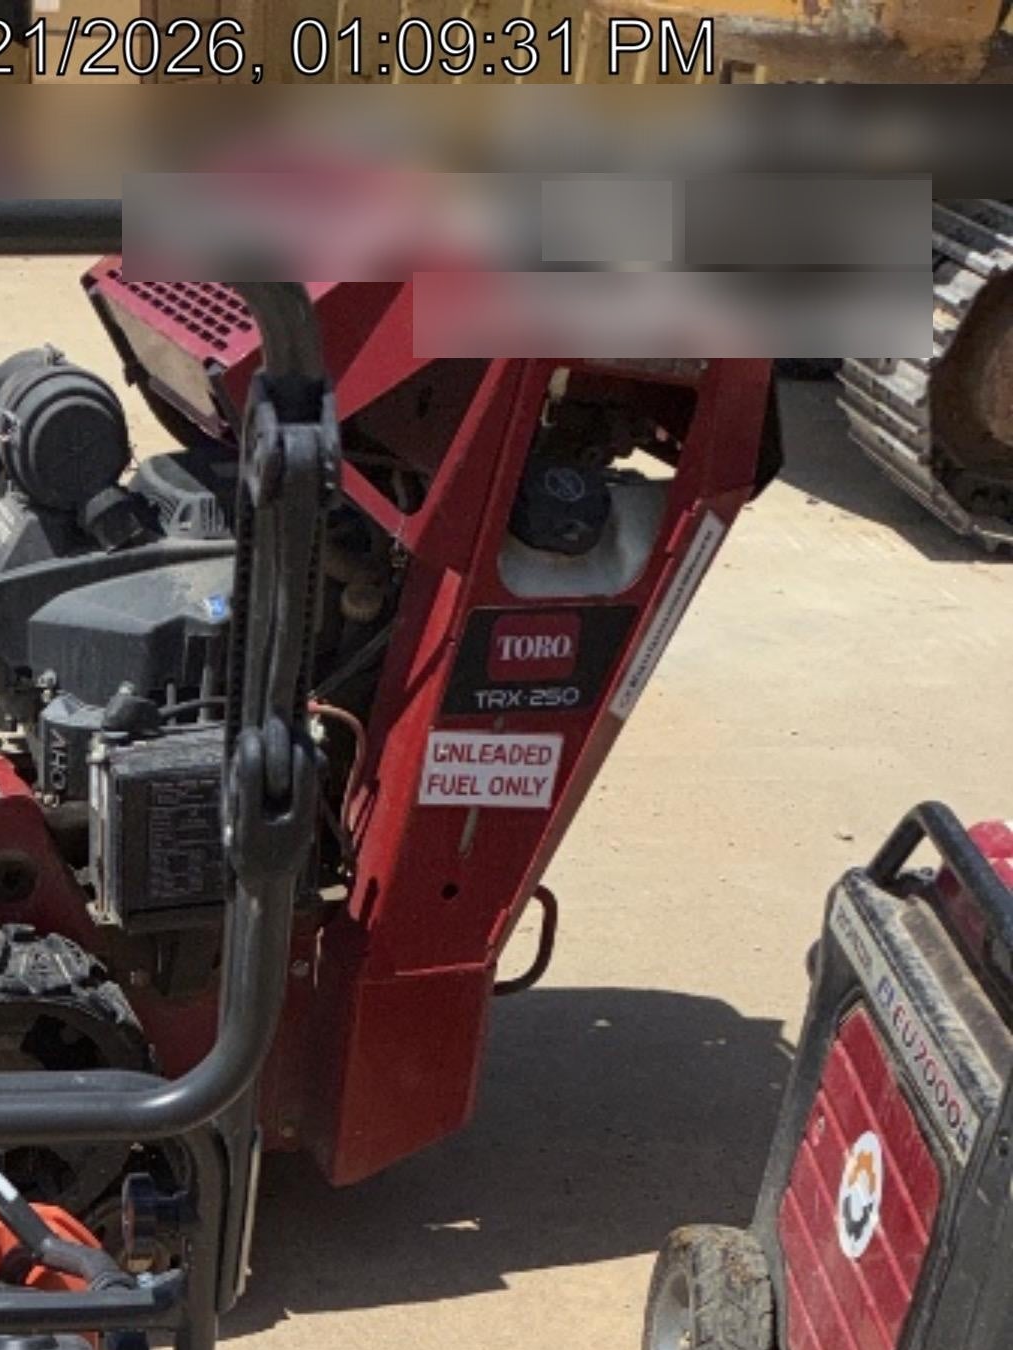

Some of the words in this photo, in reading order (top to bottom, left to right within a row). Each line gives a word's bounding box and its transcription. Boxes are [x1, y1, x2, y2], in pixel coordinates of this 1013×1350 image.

[496, 634, 573, 661] TORO
[433, 744, 553, 766] UNLEADED
[427, 774, 482, 796] FUEL
[488, 775, 548, 797] ONLY
